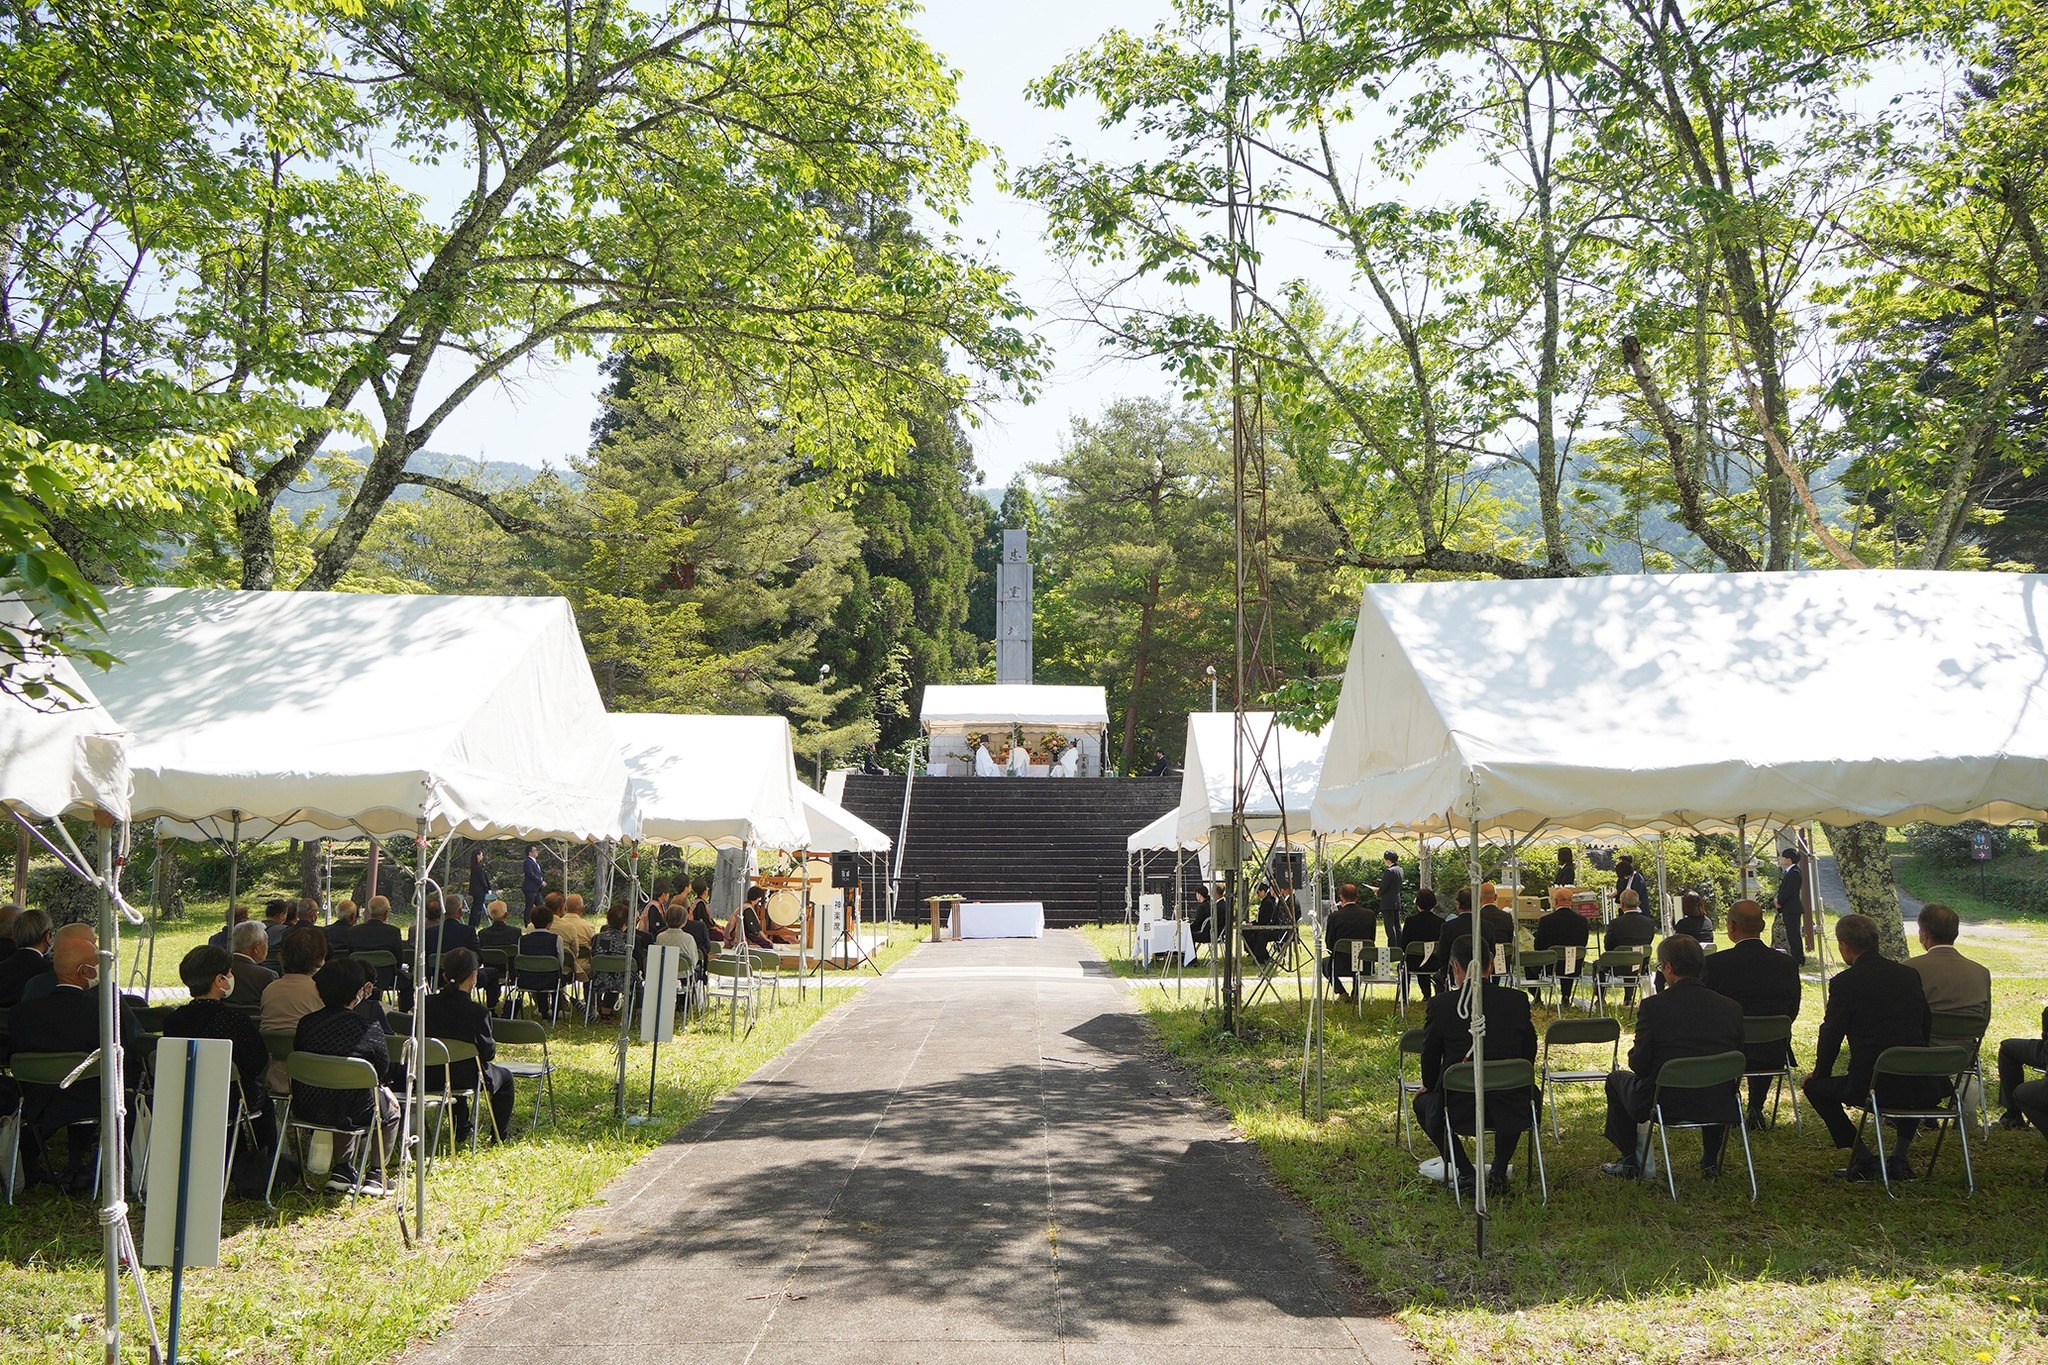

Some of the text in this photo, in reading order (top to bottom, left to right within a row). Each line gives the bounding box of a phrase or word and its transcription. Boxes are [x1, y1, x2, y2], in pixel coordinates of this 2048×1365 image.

[833, 901, 841, 931] 神楽席
[1143, 904, 1151, 932] 本部
